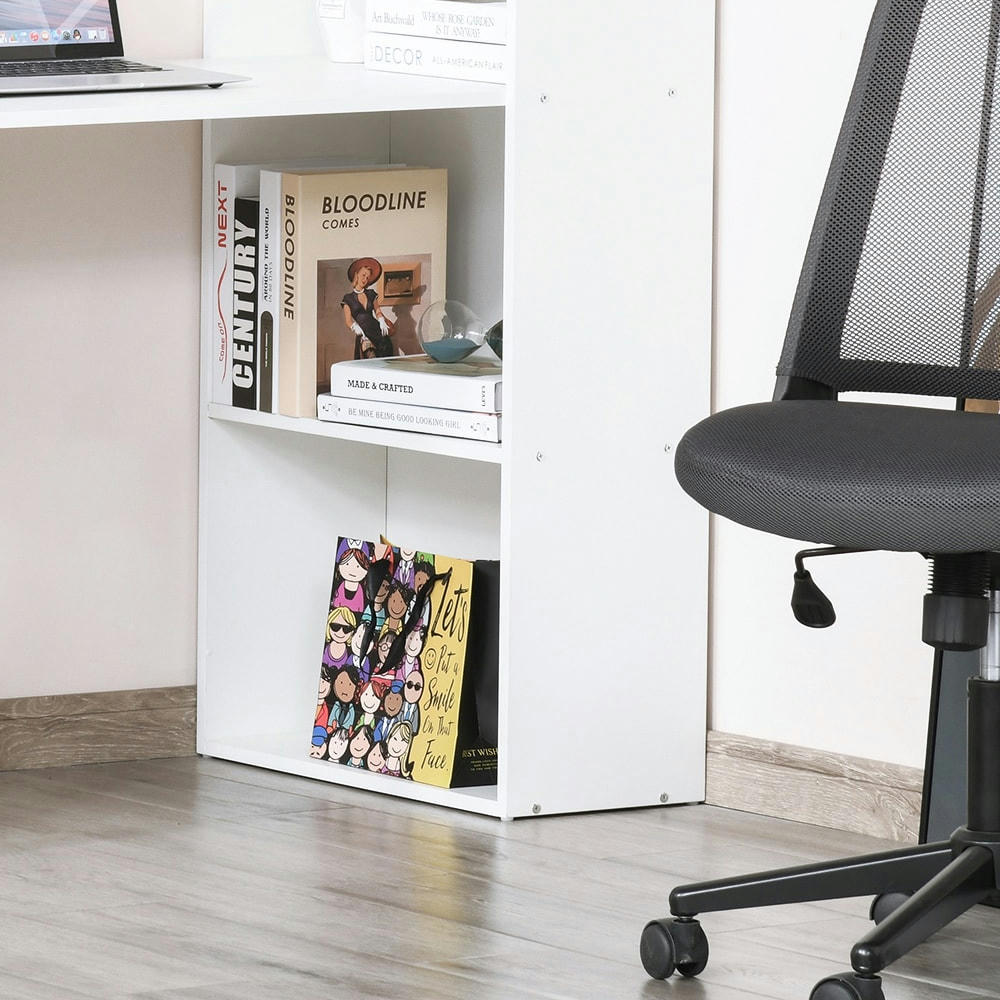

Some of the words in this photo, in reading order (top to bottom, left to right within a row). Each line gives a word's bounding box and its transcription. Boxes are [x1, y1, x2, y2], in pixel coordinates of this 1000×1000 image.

[374, 45, 423, 66] DECOR
[217, 180, 228, 248] NEXT
[321, 190, 427, 214] BLOODLINE
[322, 218, 360, 230] COMES
[283, 194, 295, 320] BLOODLINE
[232, 219, 256, 389] CENTURY
[348, 380, 370, 391] MADE
[371, 382, 377, 391] &
[378, 382, 414, 394] CRAFTED
[348, 408, 358, 417] BE
[358, 409, 374, 418] MINE
[375, 411, 395, 421] BEING
[396, 413, 414, 423] GOOD
[415, 415, 444, 427] LOOKING
[431, 567, 469, 642] Let's
[423, 678, 456, 713] Smile
